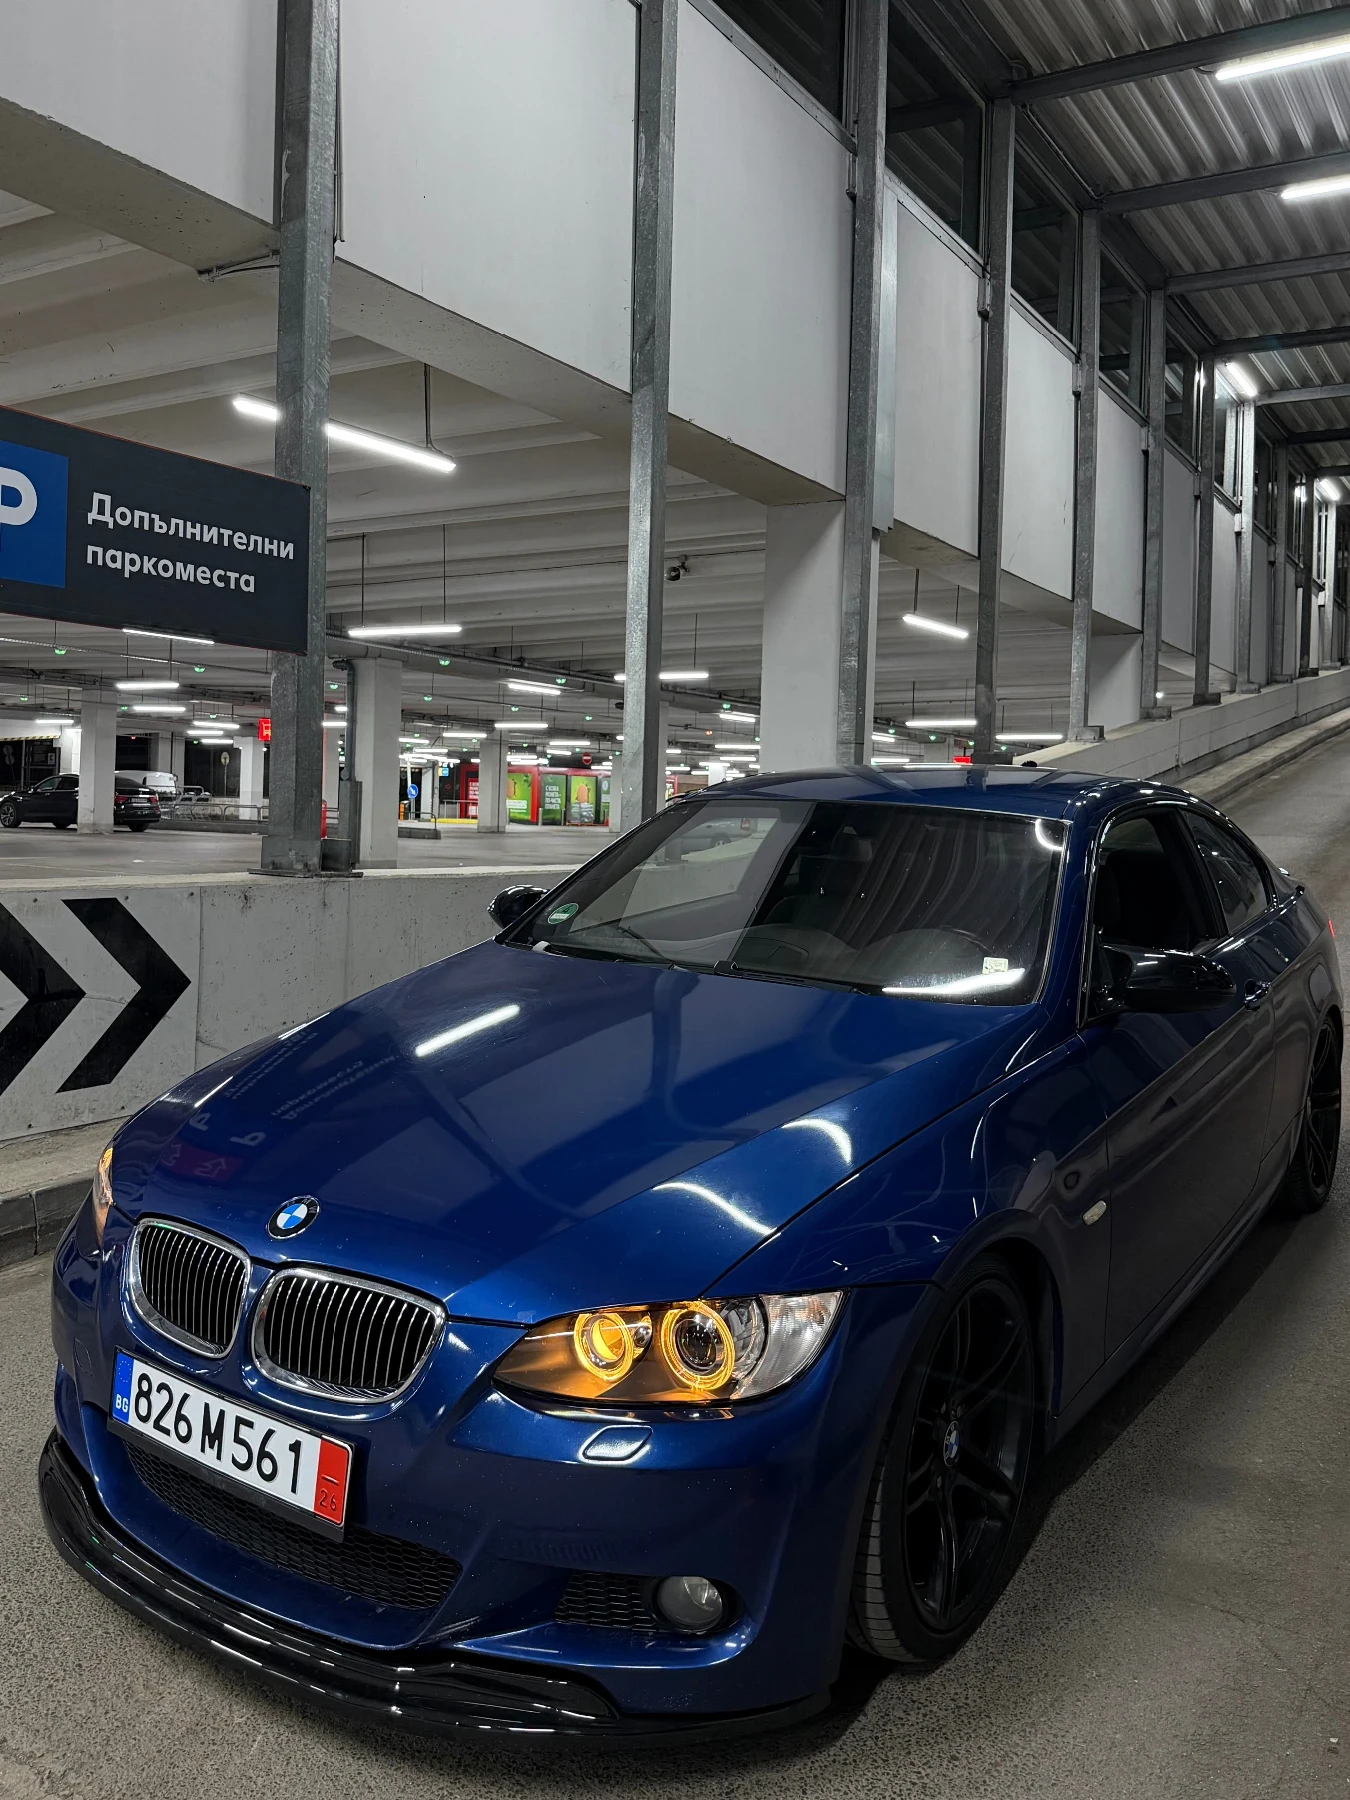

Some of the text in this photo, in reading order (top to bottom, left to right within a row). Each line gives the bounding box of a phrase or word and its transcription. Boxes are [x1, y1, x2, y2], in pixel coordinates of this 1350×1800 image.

[87, 491, 294, 560] Допълнителни
[86, 544, 255, 593] паркоместа
[115, 1394, 129, 1413] BG
[320, 1489, 337, 1511] 26
